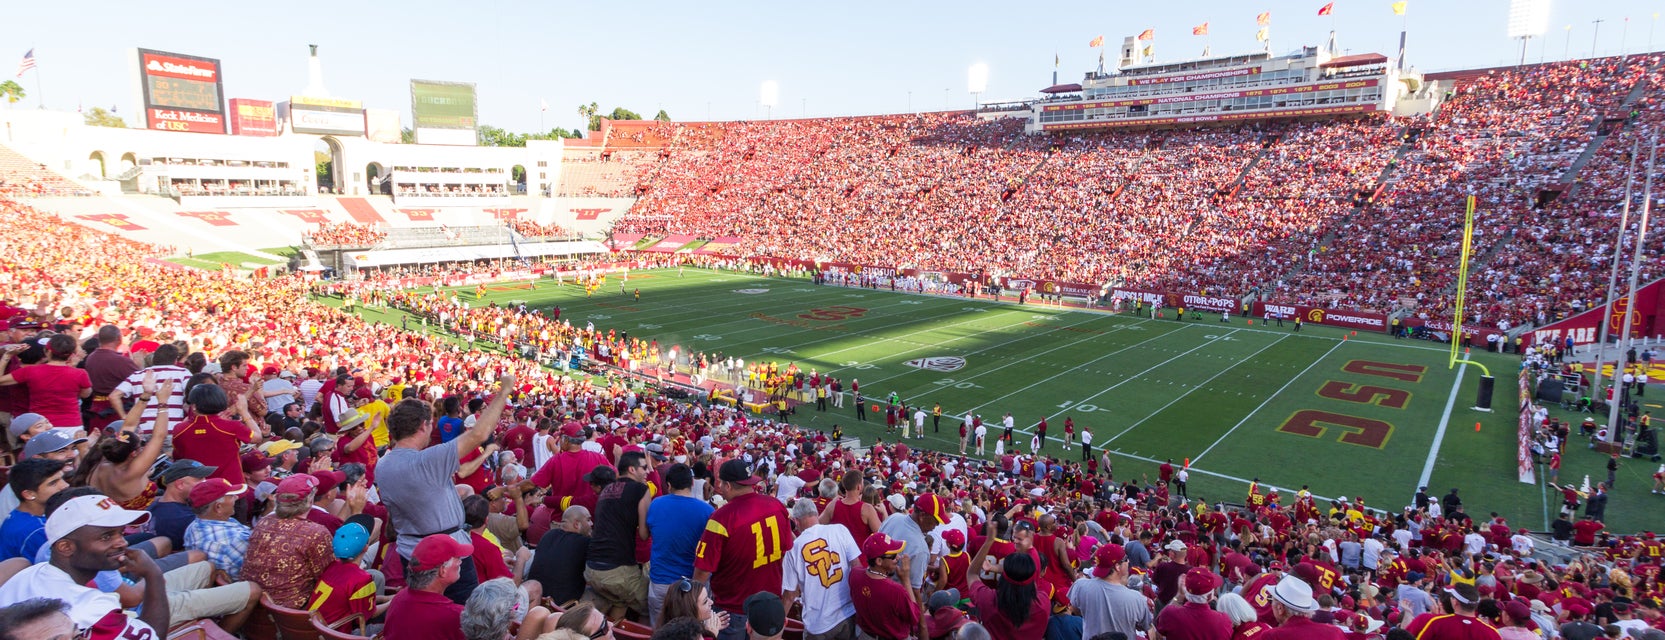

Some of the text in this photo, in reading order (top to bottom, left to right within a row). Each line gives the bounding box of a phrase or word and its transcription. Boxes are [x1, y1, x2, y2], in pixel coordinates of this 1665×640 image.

[1186, 69, 1249, 81] CHAMPIONSHIPS
[1158, 96, 1193, 104] NATIONAL
[1195, 92, 1240, 100] CHAMPIONS
[154, 109, 219, 124] Keck Medicine
[156, 120, 190, 131] of USC
[1326, 313, 1383, 326] POWERADE
[1424, 320, 1443, 330] Keck
[1055, 400, 1099, 413] 10
[1274, 359, 1429, 451] USC
[1252, 494, 1265, 505] 58
[750, 515, 783, 570] 11
[1649, 545, 1661, 557] 11
[801, 537, 843, 590] SC
[308, 579, 335, 613] 7
